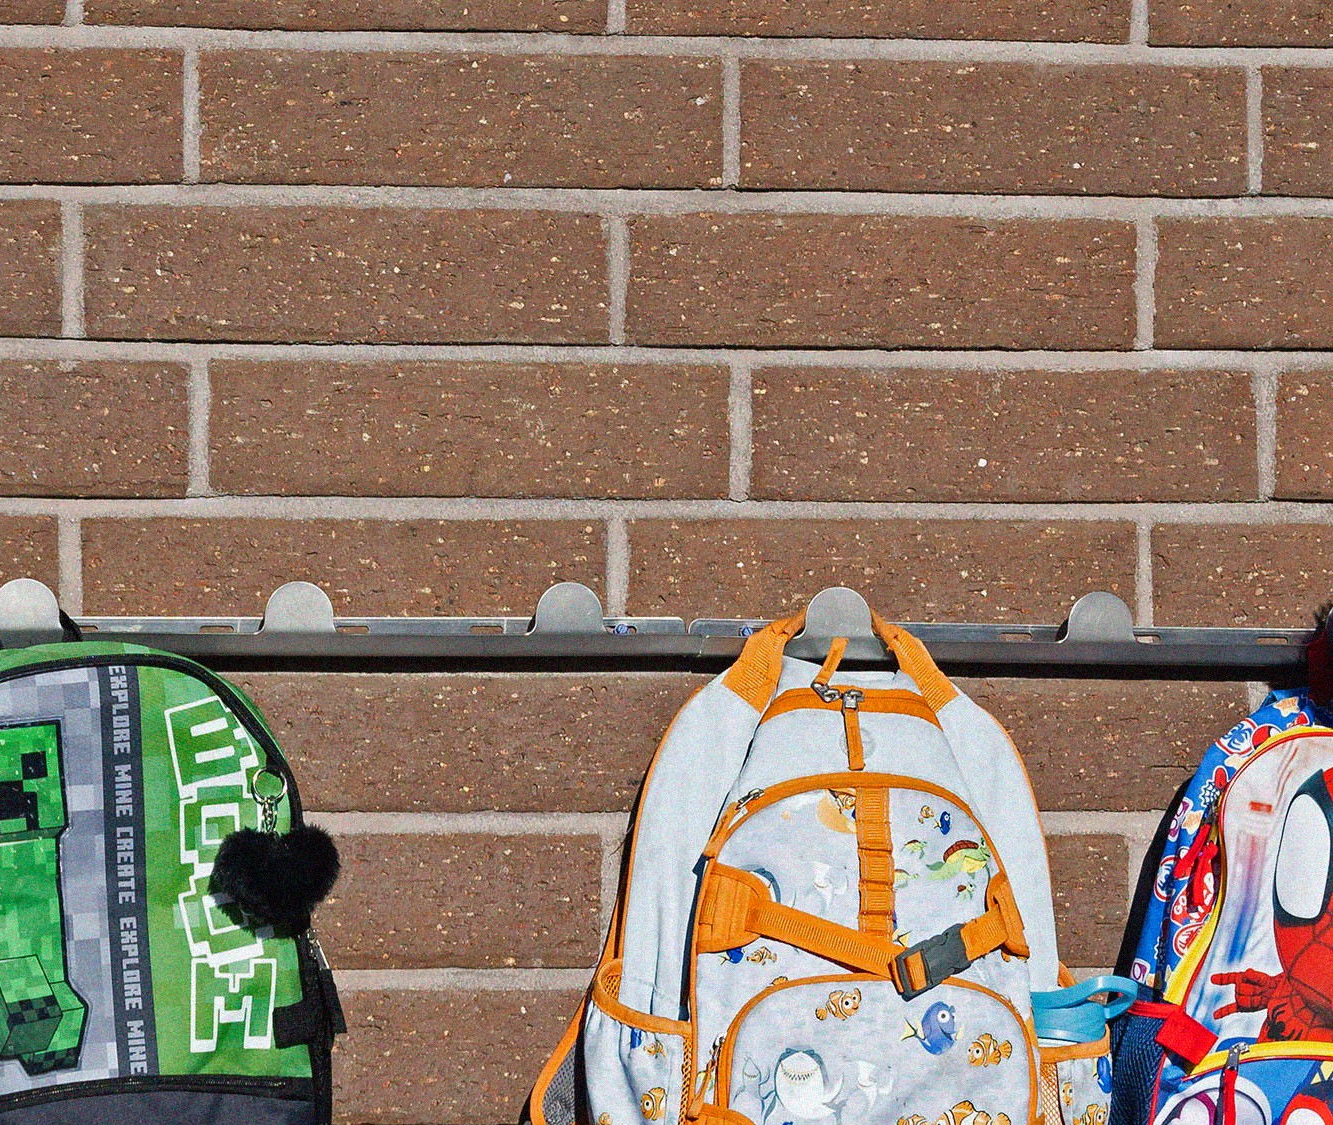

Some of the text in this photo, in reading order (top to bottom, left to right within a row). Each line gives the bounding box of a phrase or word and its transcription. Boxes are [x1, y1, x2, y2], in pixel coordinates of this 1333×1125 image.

[108, 665, 147, 1075] EXPLORE MINE CREATE EXPLORE MINE
